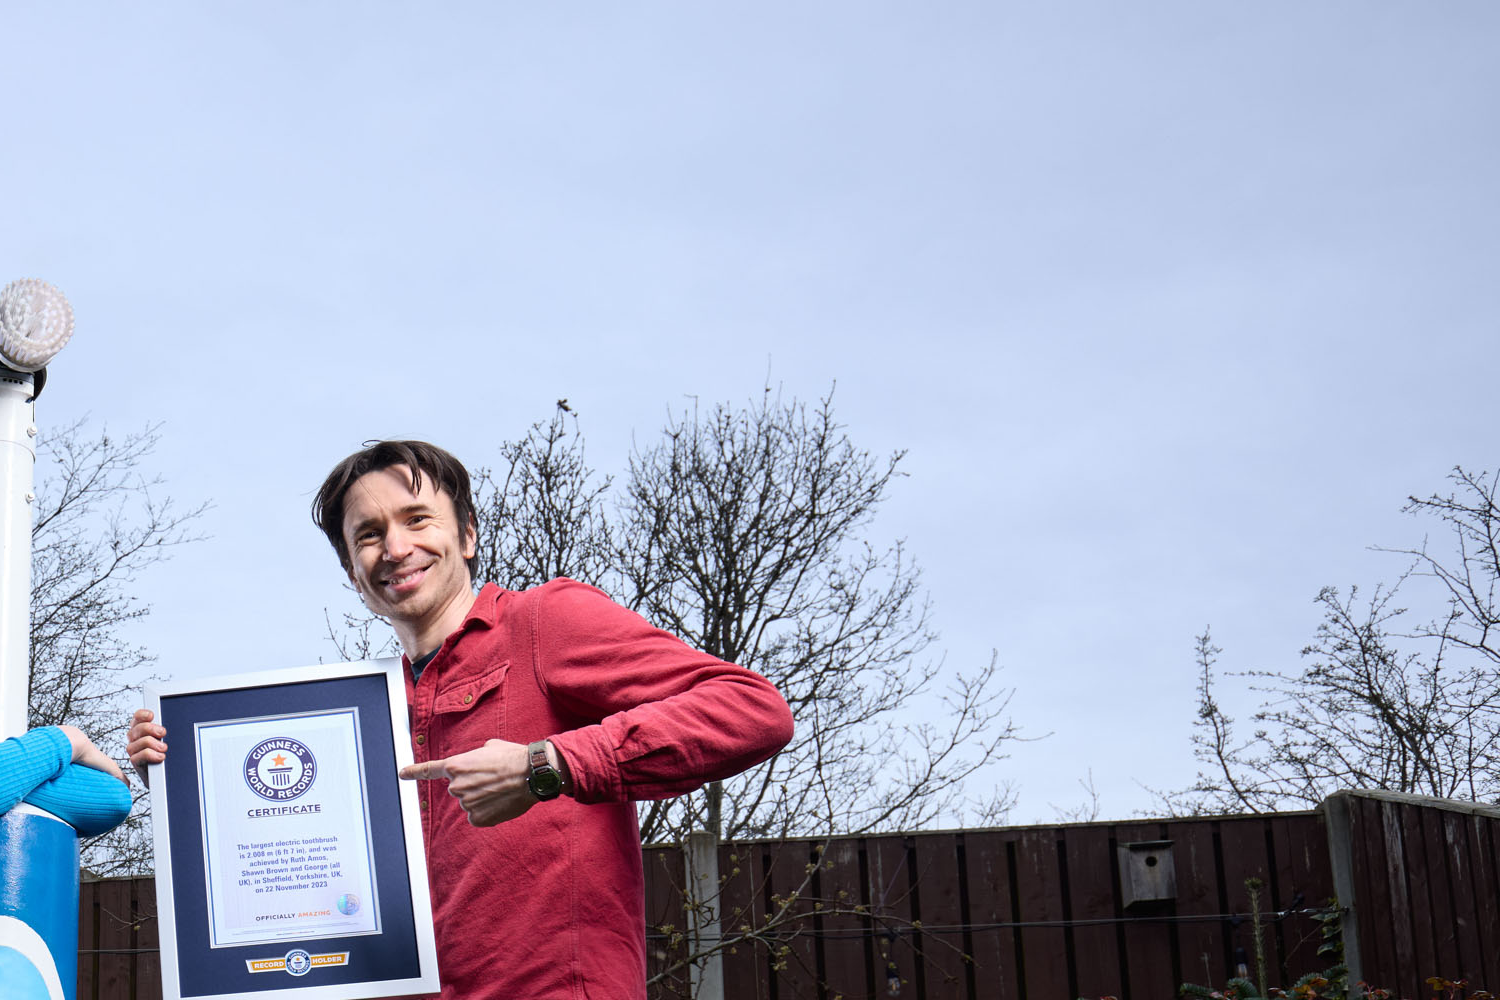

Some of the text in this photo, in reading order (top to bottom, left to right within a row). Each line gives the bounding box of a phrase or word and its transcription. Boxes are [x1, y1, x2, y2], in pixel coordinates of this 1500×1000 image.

[252, 740, 306, 760] GUINNESS
[248, 762, 313, 799] WORLD RECORDS
[247, 804, 321, 817] CERTIFICATE
[237, 836, 338, 851] The largest electric toothbrush
[275, 848, 282, 857] (6
[309, 845, 321, 853] and
[249, 858, 279, 867] achieved
[280, 857, 289, 865] by
[290, 856, 306, 864] Ruth
[266, 867, 289, 875] Brown
[290, 865, 303, 873] and
[304, 863, 328, 872] George
[329, 861, 341, 870] (all
[262, 875, 294, 884] Sheffield,
[295, 872, 330, 881] Yorkshire,
[265, 885, 274, 893] 22
[275, 883, 310, 892] November
[311, 880, 328, 889] 2023
[255, 910, 331, 922] OFFICIALLY AMAZING
[254, 961, 284, 969] RECORD
[312, 956, 342, 964] HOLDER
